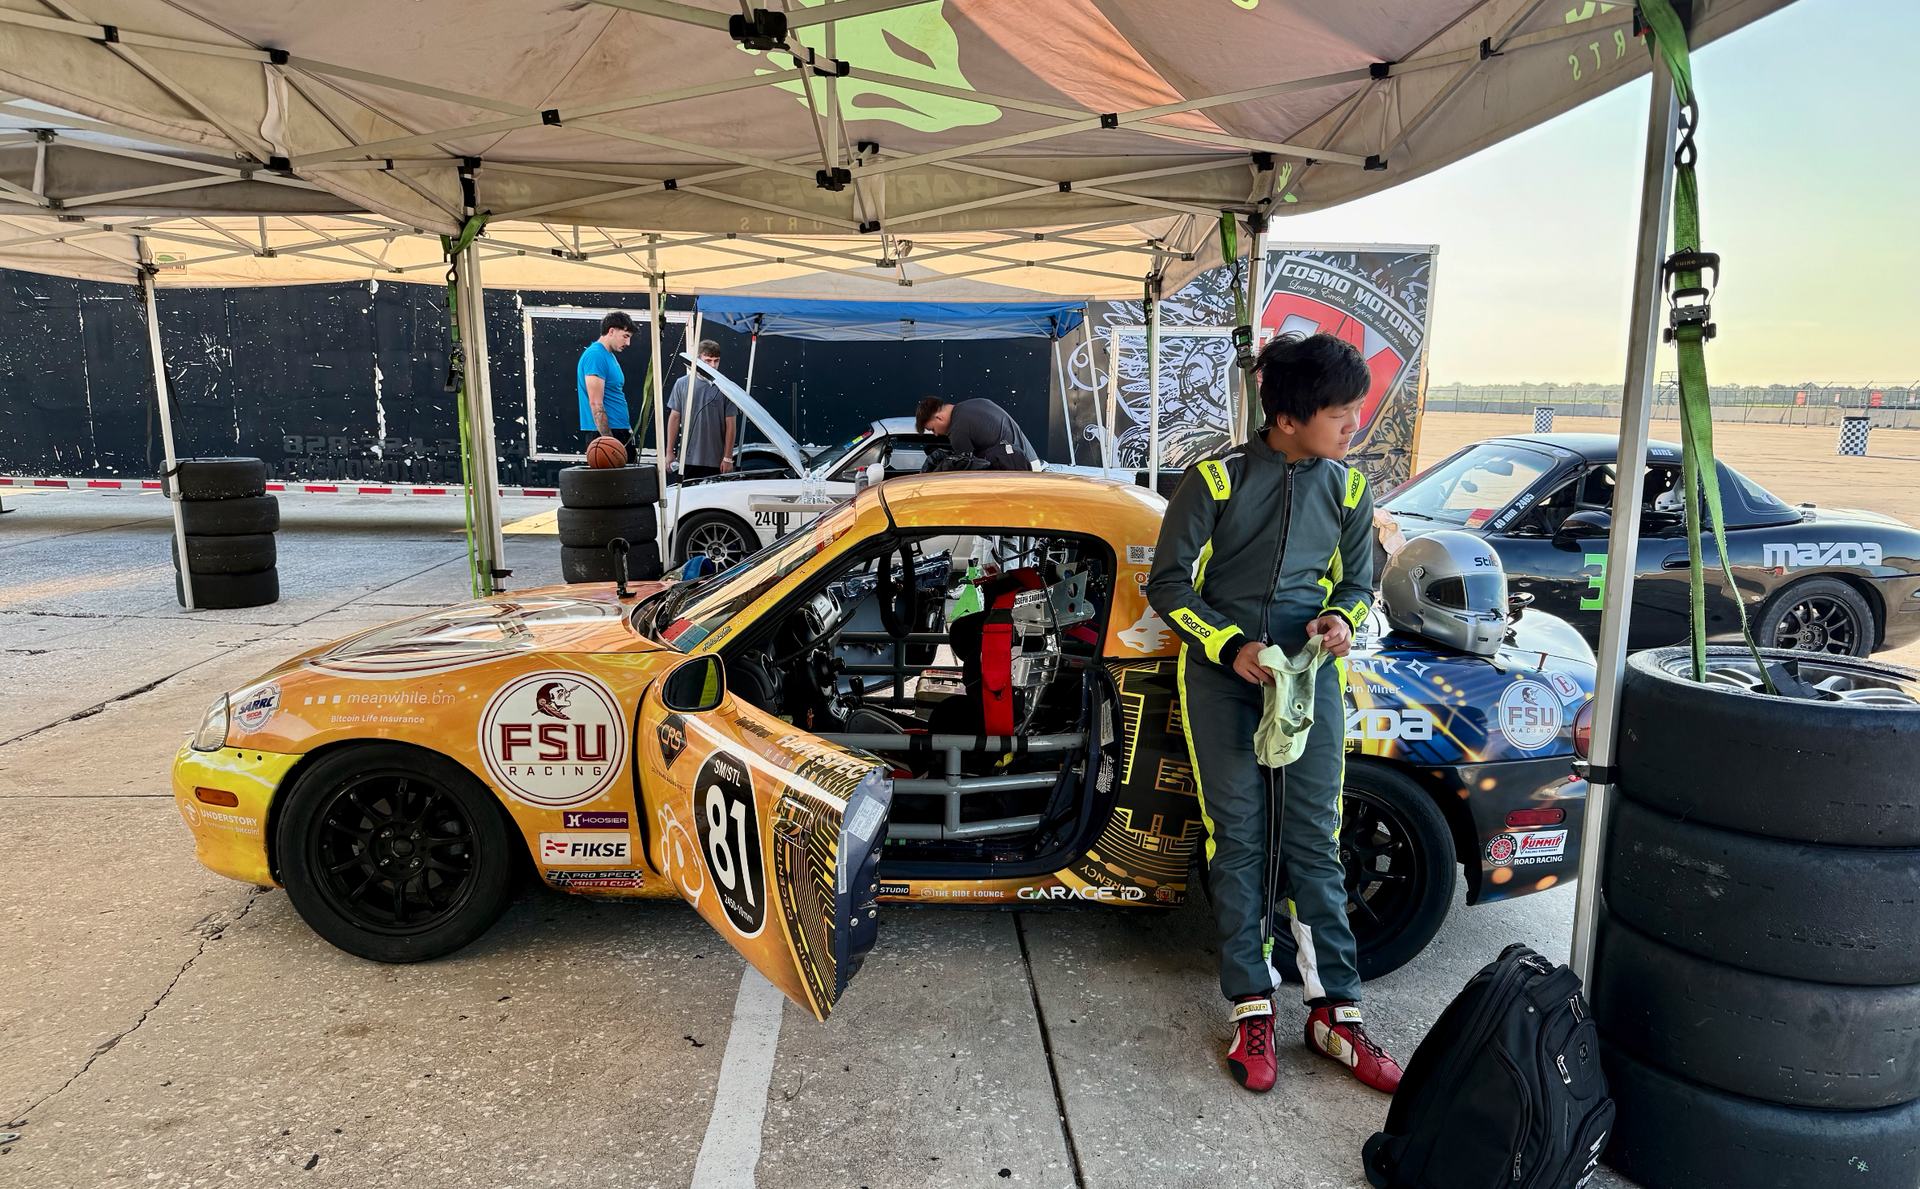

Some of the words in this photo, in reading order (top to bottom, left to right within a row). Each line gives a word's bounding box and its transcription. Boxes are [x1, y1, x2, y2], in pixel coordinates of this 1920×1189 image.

[1281, 263, 1351, 293] COSMO
[1353, 287, 1421, 347] MOTORS
[1207, 463, 1225, 491] sparco
[1493, 520, 1505, 530] 40
[1503, 508, 1518, 523] mm
[1515, 492, 1535, 510] 2465
[1181, 612, 1211, 638] sparco
[347, 691, 456, 706] meanwhile.bm
[331, 714, 360, 723] Bitcoin
[361, 714, 379, 723] Life
[380, 714, 425, 724] Insurance
[1507, 706, 1554, 726] FSU
[497, 723, 609, 762] FSU
[509, 766, 602, 776] RACING
[713, 760, 741, 788] SM/STL
[201, 808, 257, 827] UNDERSTORY
[570, 843, 627, 857] FIKSE
[705, 784, 756, 908] 81
[1521, 834, 1564, 851] SUMMIT
[1514, 857, 1535, 866] ROAD
[1536, 855, 1563, 864] RACING
[973, 890, 1005, 898] LOUNGE
[1016, 886, 1116, 901] GARAGE
